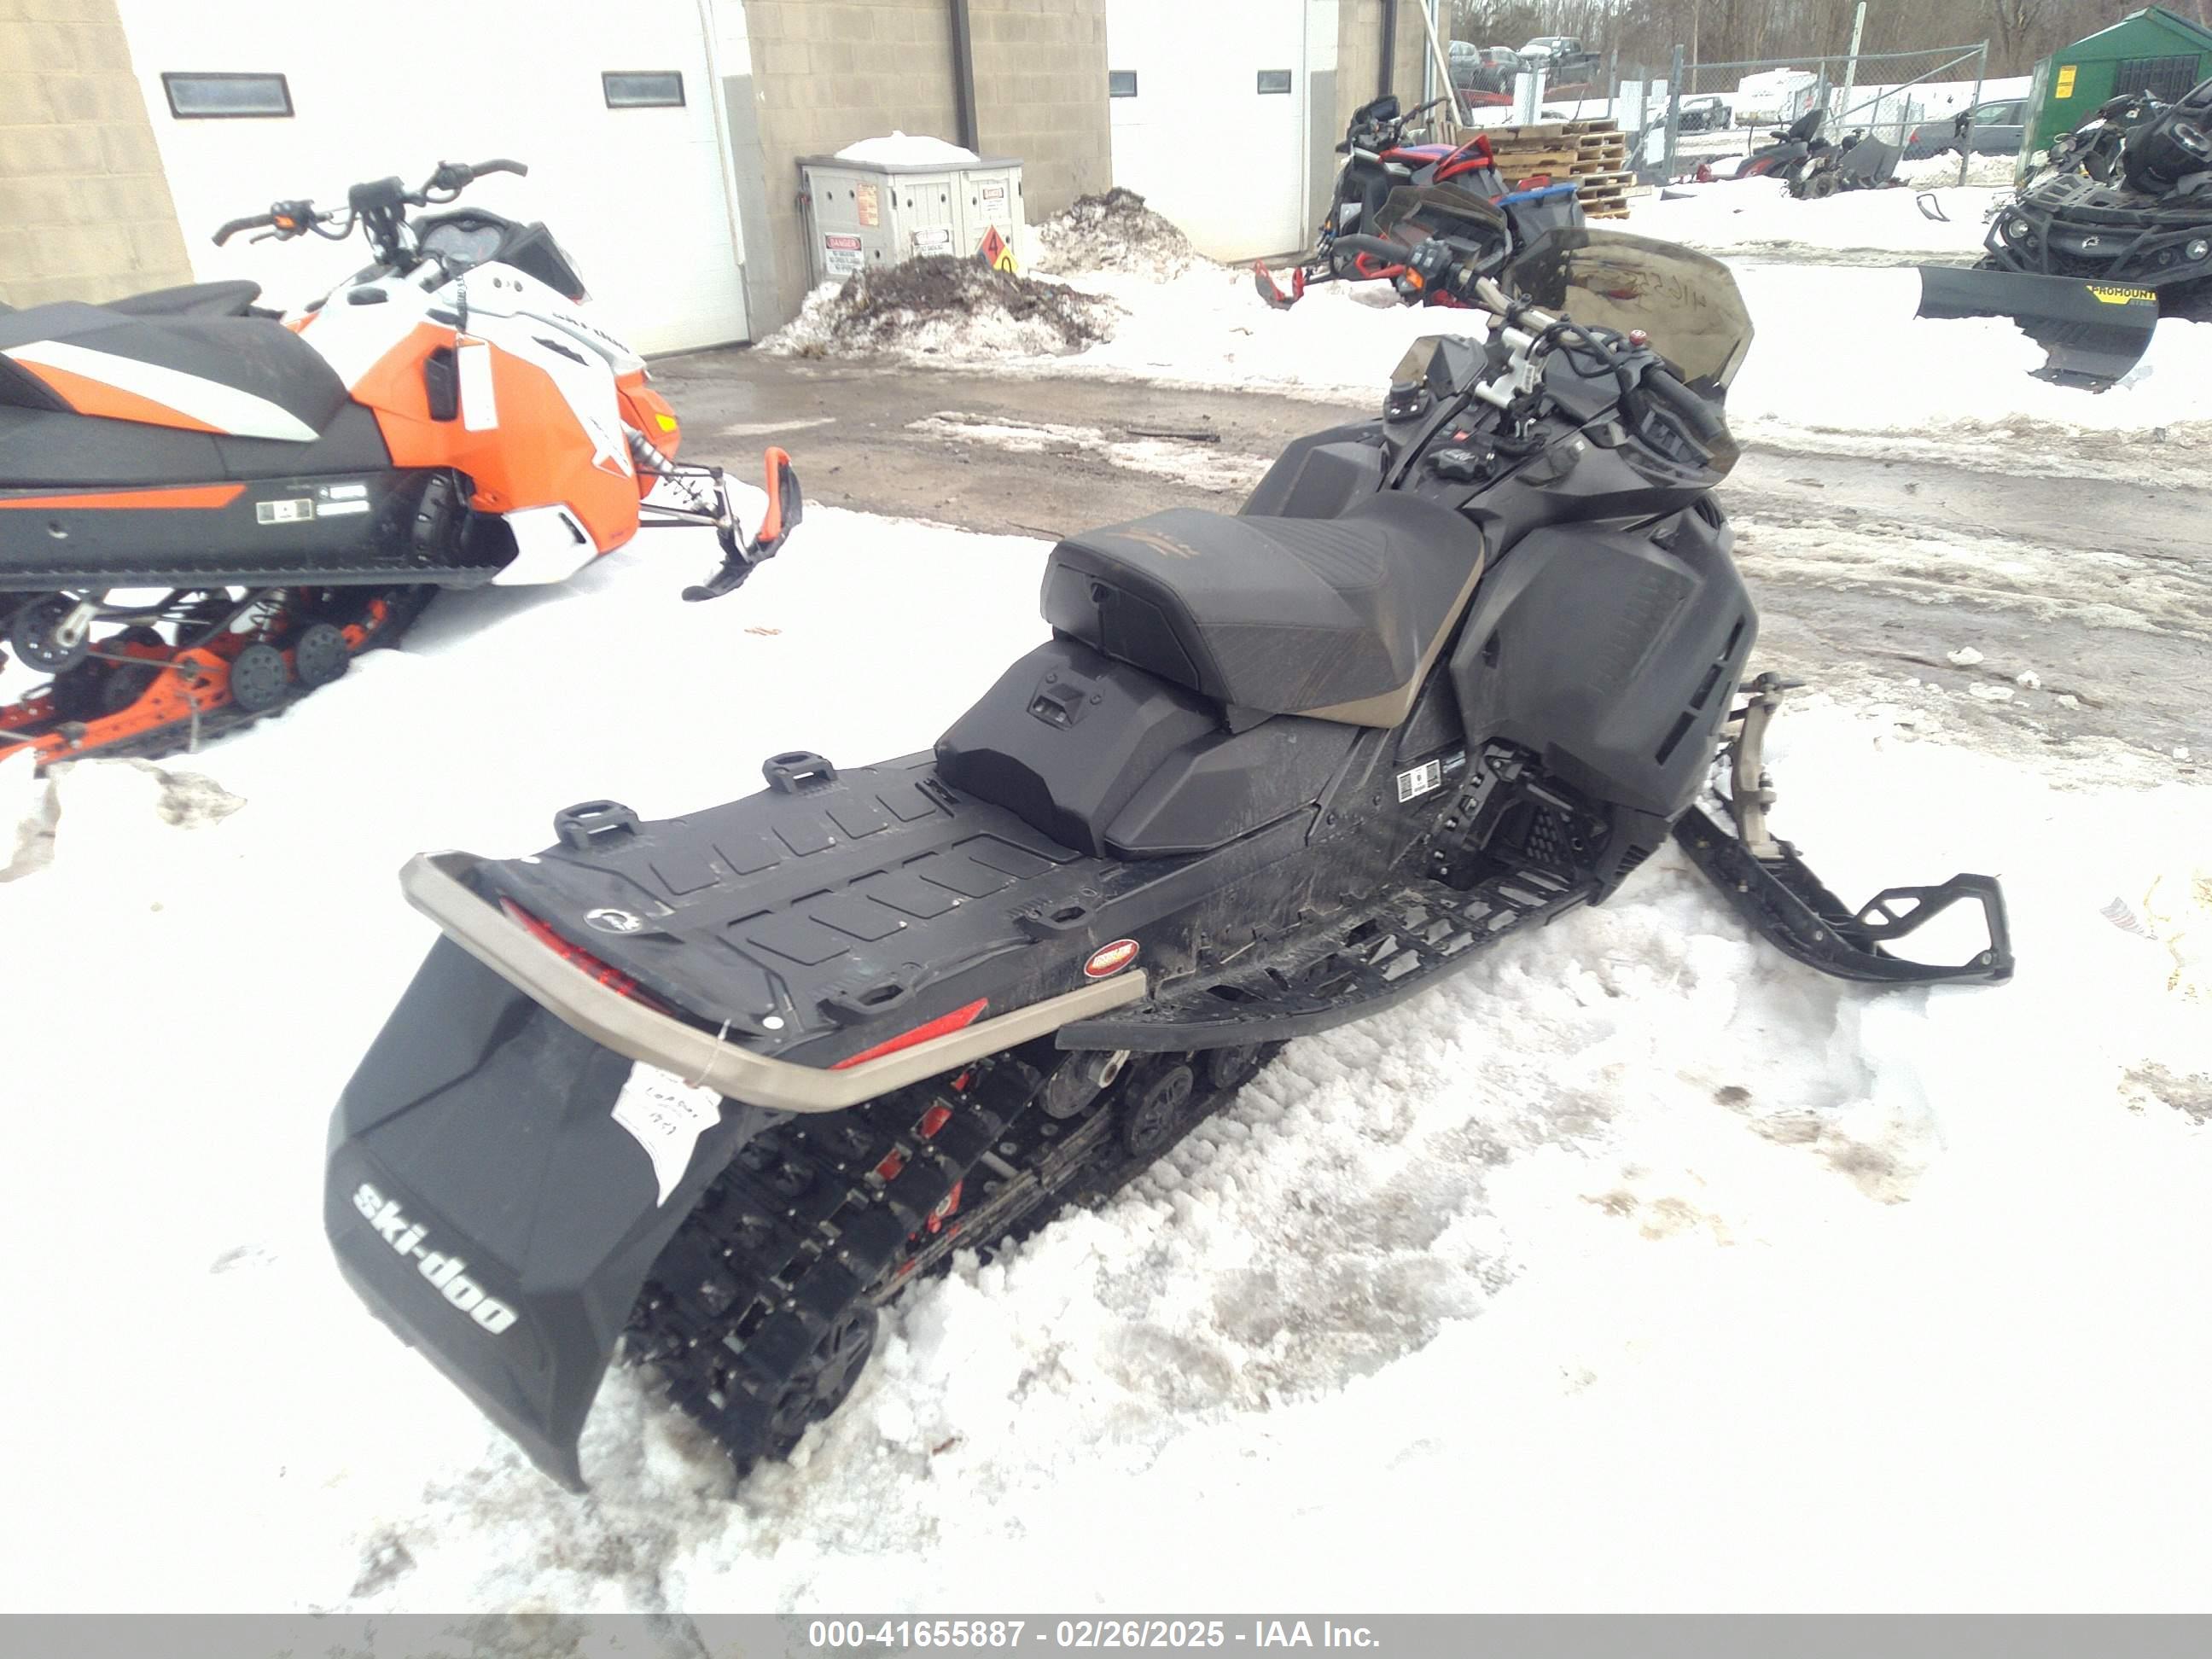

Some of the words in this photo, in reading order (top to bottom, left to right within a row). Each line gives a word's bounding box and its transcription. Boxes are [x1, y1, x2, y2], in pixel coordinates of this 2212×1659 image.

[830, 238, 857, 247] DANGER
[988, 231, 998, 257] 4
[2092, 286, 2157, 299] PROMOUNT
[352, 1184, 518, 1335] ski-doo
